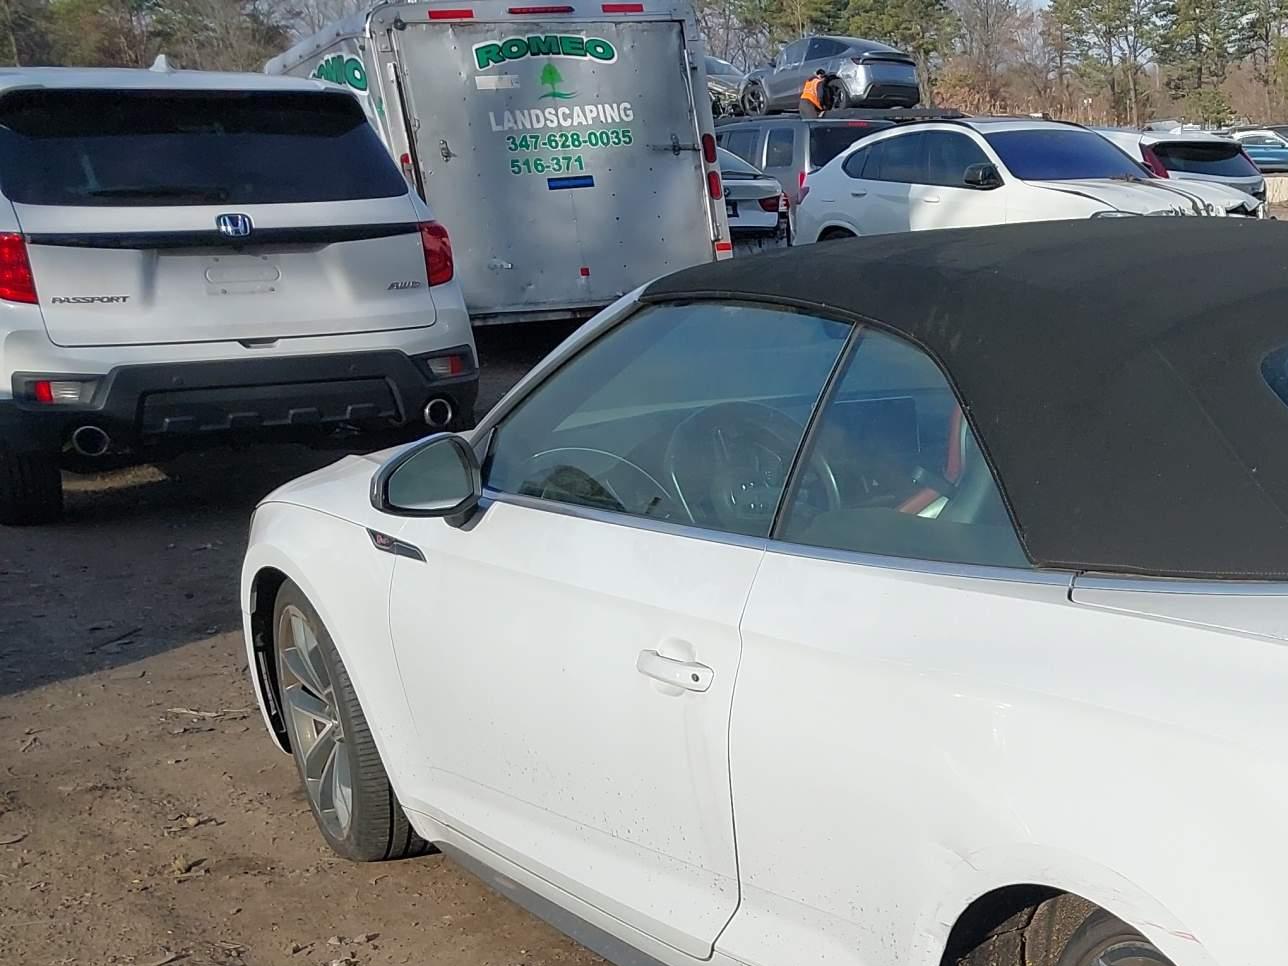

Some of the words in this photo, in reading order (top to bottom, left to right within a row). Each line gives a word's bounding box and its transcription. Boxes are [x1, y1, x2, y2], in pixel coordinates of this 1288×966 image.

[474, 35, 616, 69] ROMEO
[489, 101, 634, 131] LANDSCAPING
[506, 129, 633, 152] 347-628-0035
[510, 155, 585, 175] 516-371
[51, 295, 130, 304] PASSPORT
